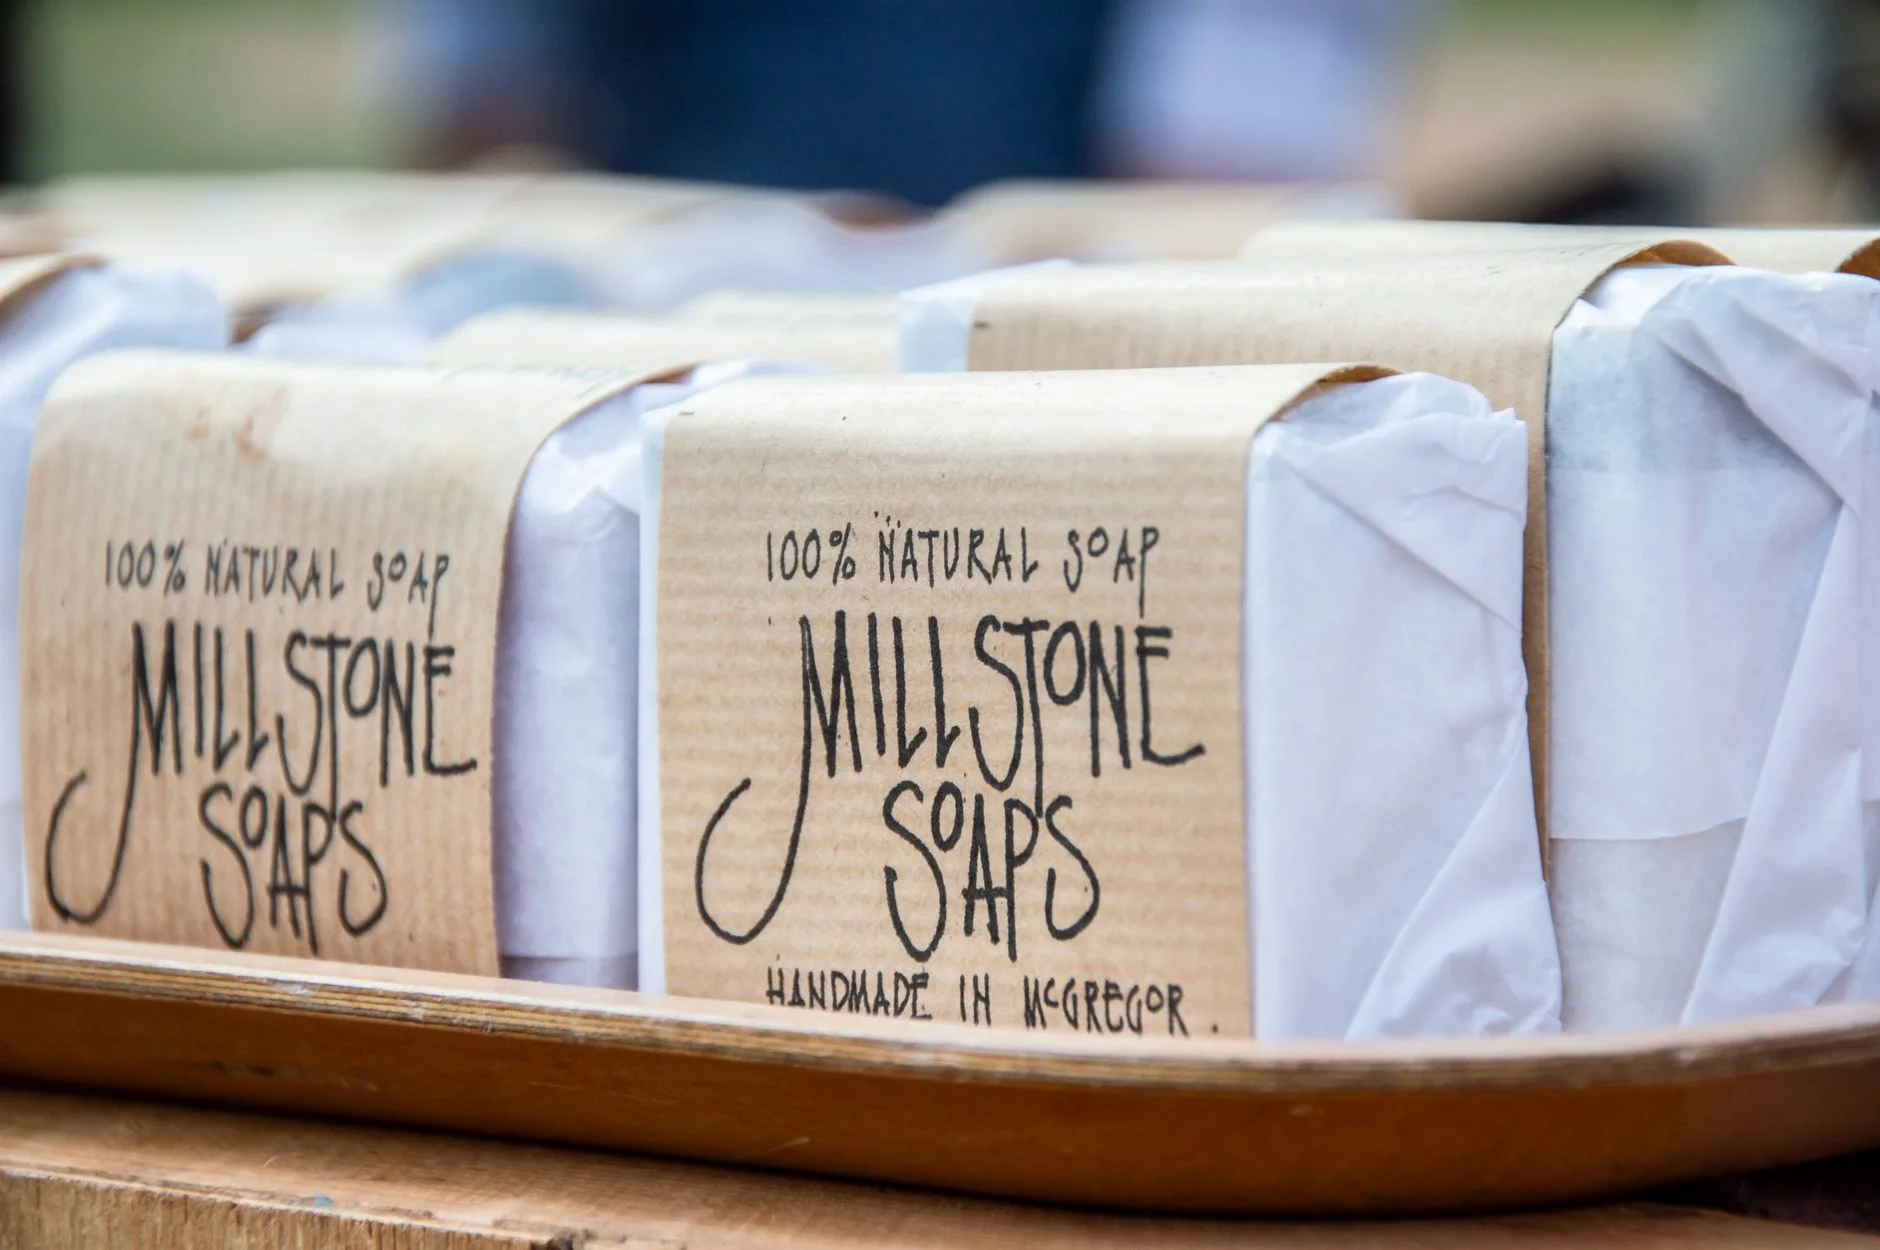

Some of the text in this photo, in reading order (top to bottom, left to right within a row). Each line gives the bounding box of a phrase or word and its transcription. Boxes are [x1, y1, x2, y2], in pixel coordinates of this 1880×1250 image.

[105, 539, 451, 640] 100% NATURAL SOAP
[766, 522, 1161, 619] 100% NATURAL SOAP
[44, 618, 478, 925] MILLSTONE
[695, 609, 1207, 946] MILLSTONE
[198, 781, 388, 957] SOAPS
[881, 779, 1100, 963] SOAPS
[765, 965, 934, 1021] HANDMADE
[959, 971, 992, 1027] IN
